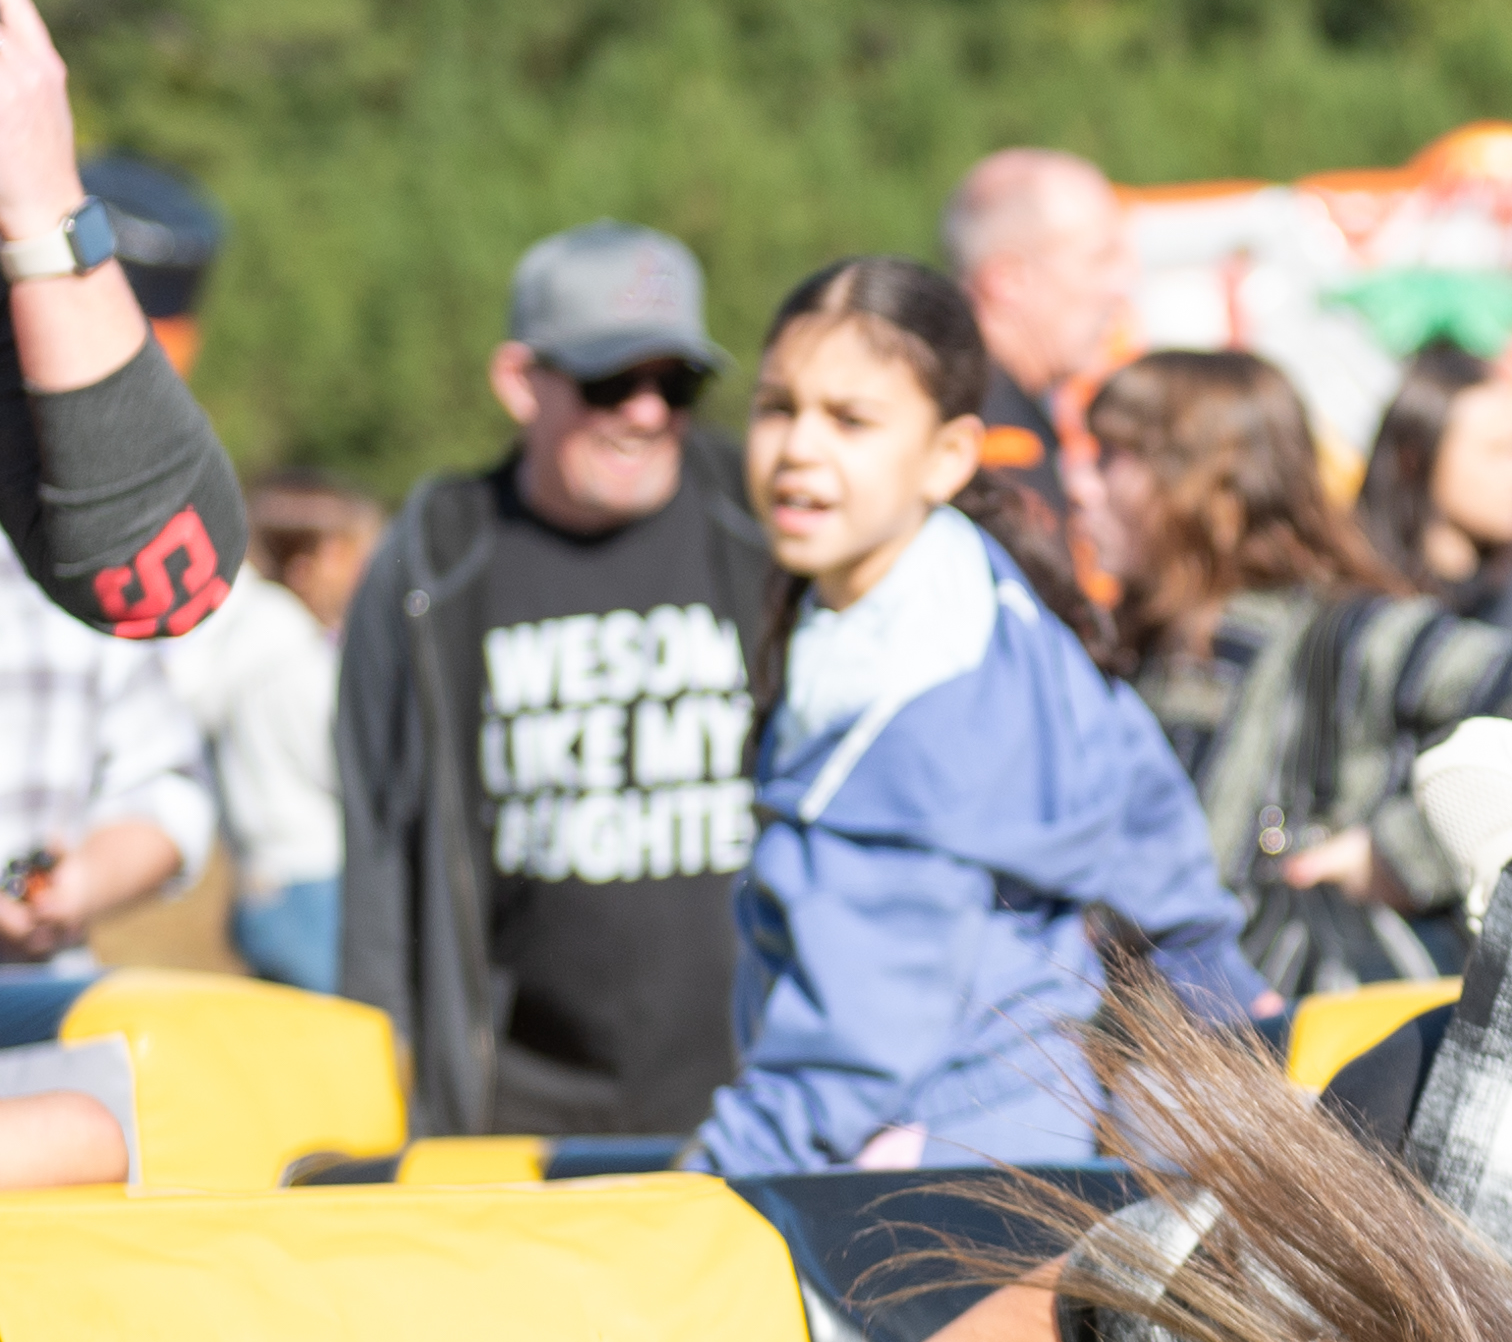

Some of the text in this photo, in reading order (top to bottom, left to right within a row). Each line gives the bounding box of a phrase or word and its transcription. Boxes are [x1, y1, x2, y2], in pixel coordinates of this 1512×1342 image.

[483, 603, 749, 716] WESOM
[480, 692, 755, 796] LIKE MY
